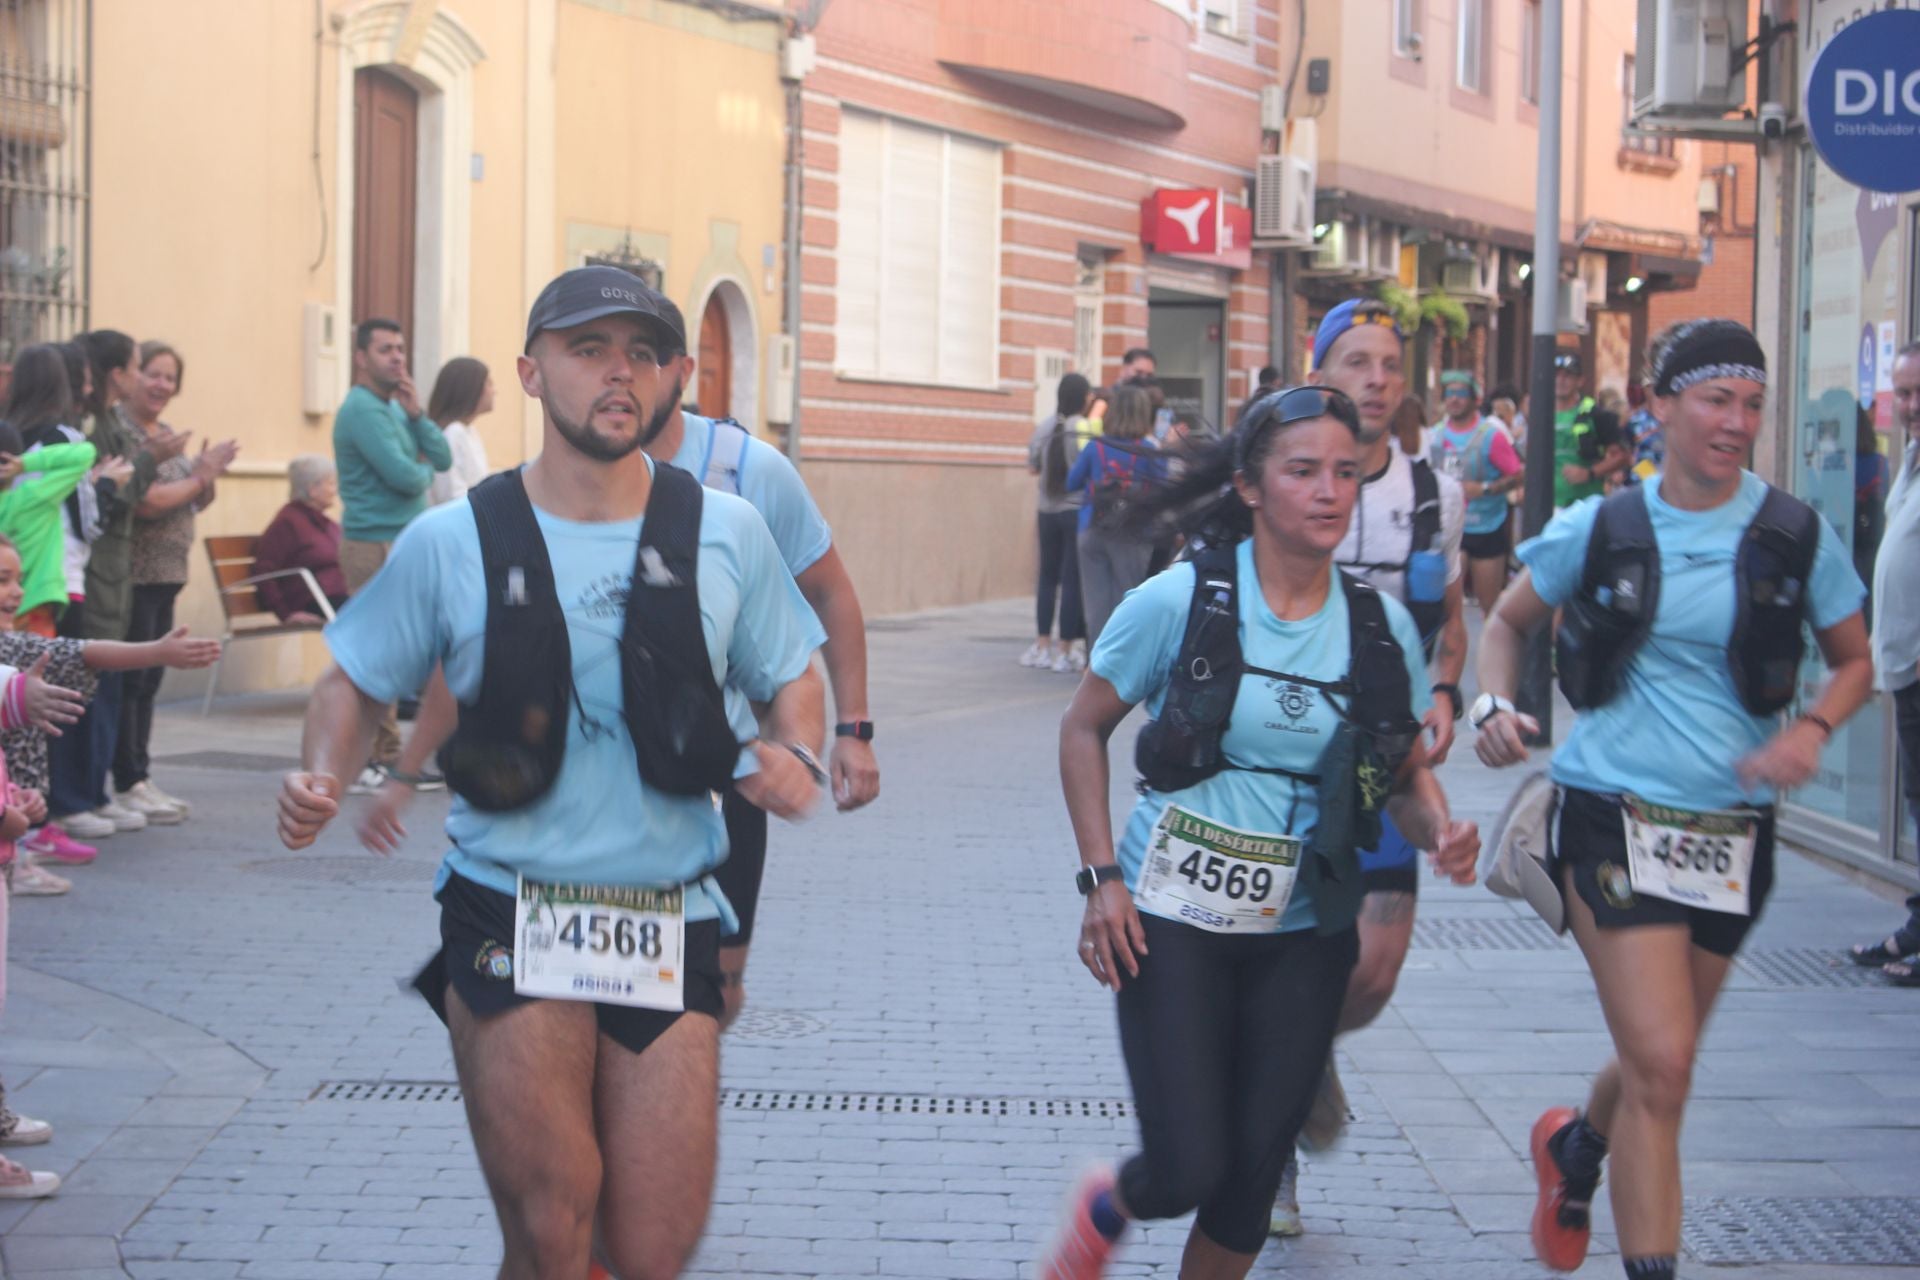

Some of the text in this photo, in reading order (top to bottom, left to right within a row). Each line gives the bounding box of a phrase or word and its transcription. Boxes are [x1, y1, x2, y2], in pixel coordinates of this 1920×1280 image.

[1835, 122, 1914, 136] Distribuidor
[1183, 819, 1201, 837] LA
[1203, 827, 1289, 857] DESÉRTICA
[1653, 833, 1733, 874] 4566
[1178, 849, 1273, 903] 4569
[558, 913, 663, 960] 4568
